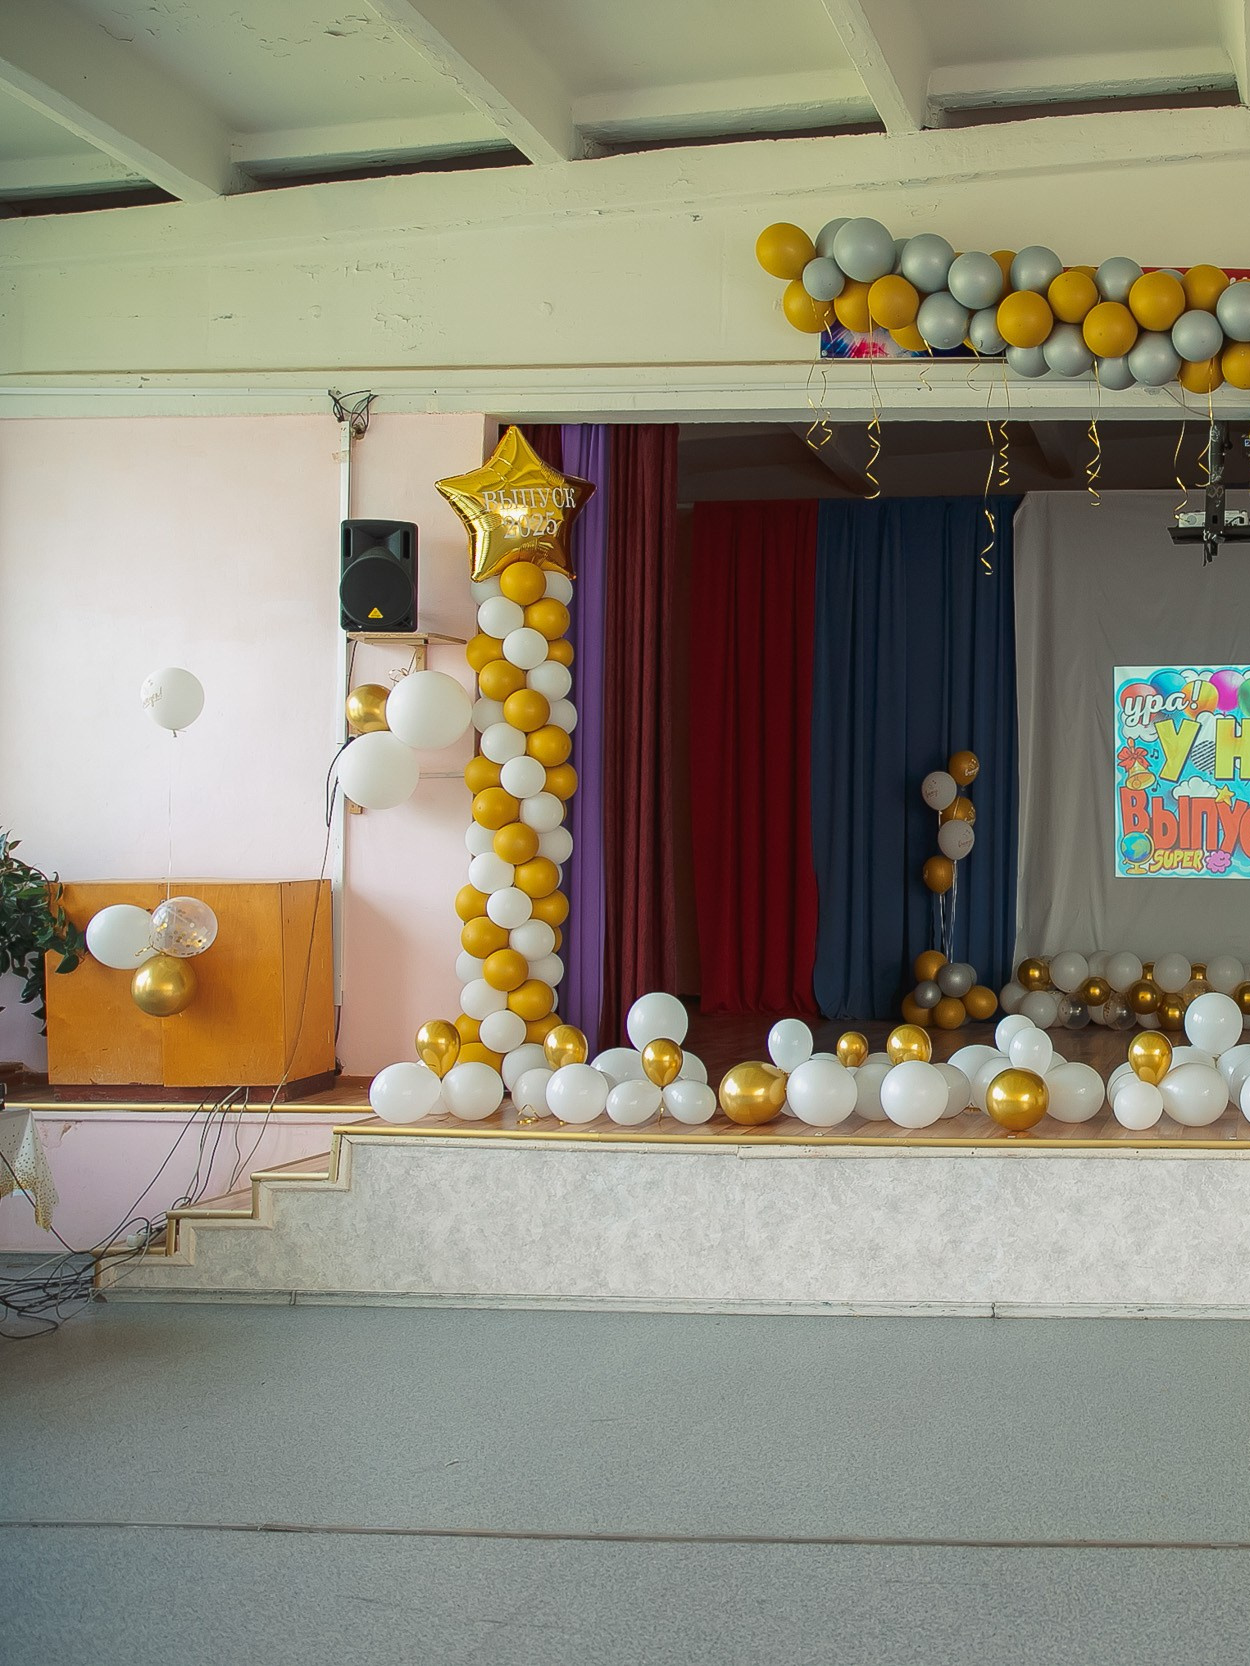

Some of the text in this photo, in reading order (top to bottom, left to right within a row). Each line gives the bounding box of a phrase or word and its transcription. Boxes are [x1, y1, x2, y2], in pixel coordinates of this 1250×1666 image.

[482, 487, 577, 513] ВЫПУСК
[503, 512, 558, 539] 2025
[1121, 680, 1200, 727] ура!
[1154, 718, 1201, 782] У
[1151, 849, 1204, 872] SUPER
